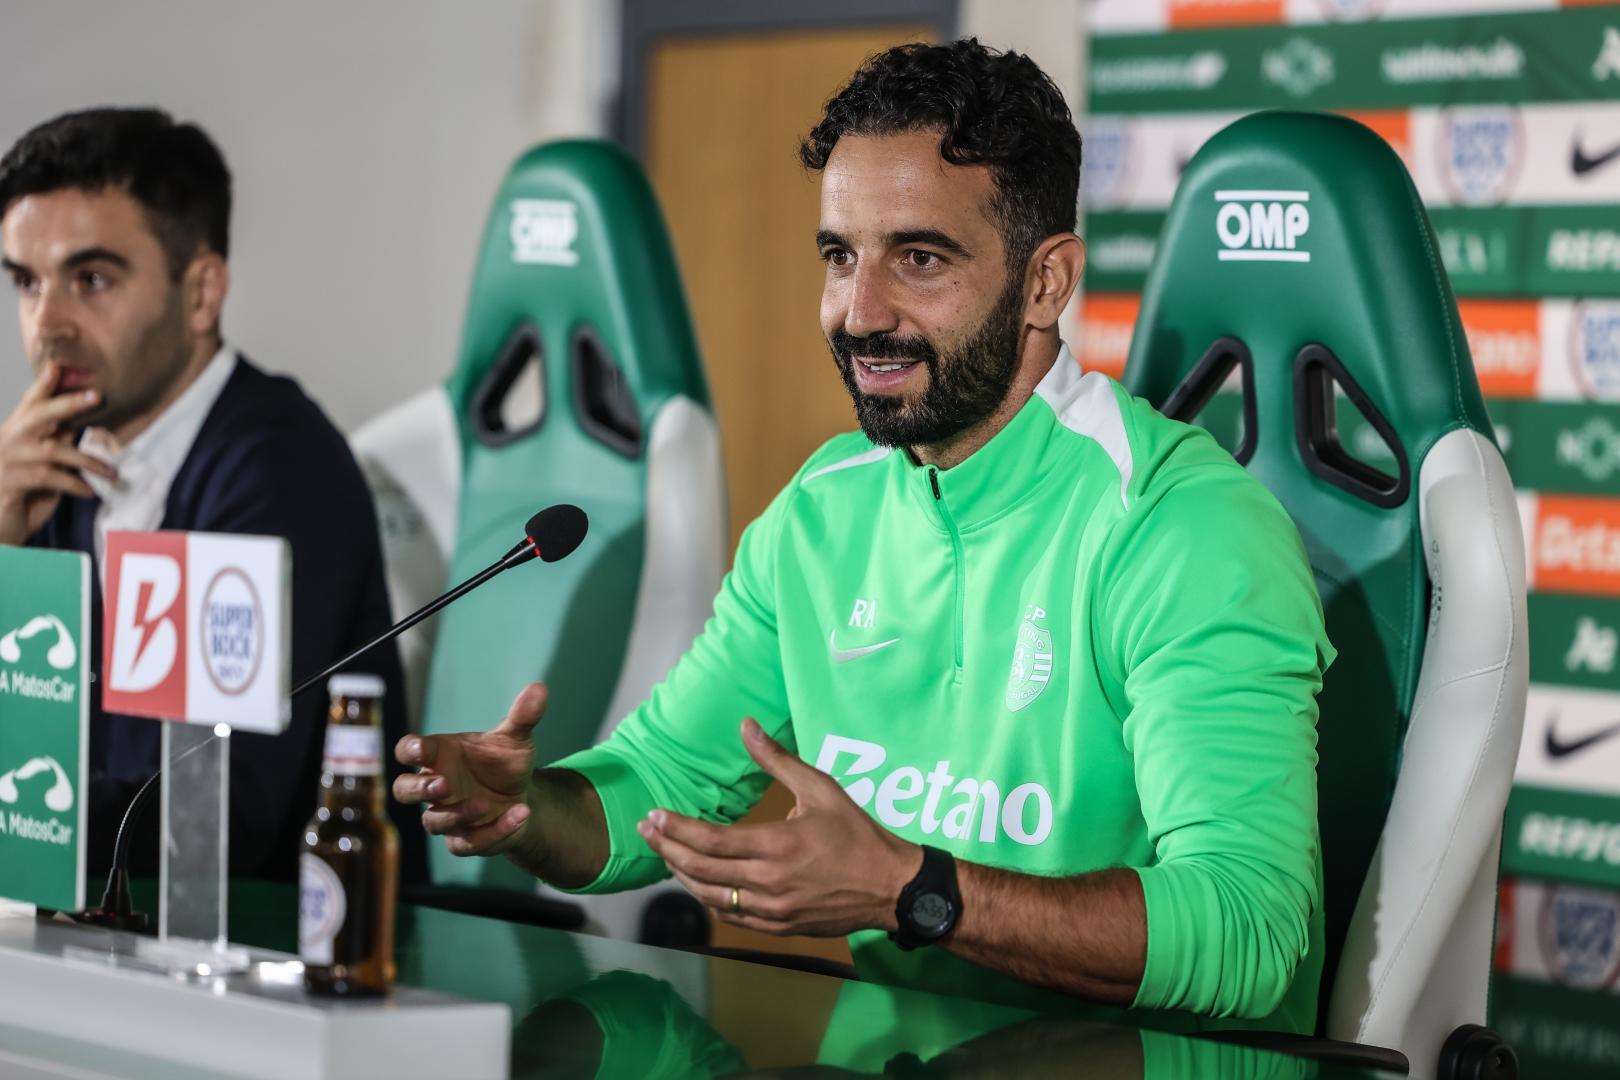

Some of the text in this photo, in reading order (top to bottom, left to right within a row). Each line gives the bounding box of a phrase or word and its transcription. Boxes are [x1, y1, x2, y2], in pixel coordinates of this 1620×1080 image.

[1216, 202, 1310, 249] OMP
[1547, 230, 1620, 272] REP
[848, 599, 877, 628] RA
[12, 671, 76, 703] MatosCar
[814, 734, 1054, 847] Betano
[9, 811, 73, 846] MatosCar
